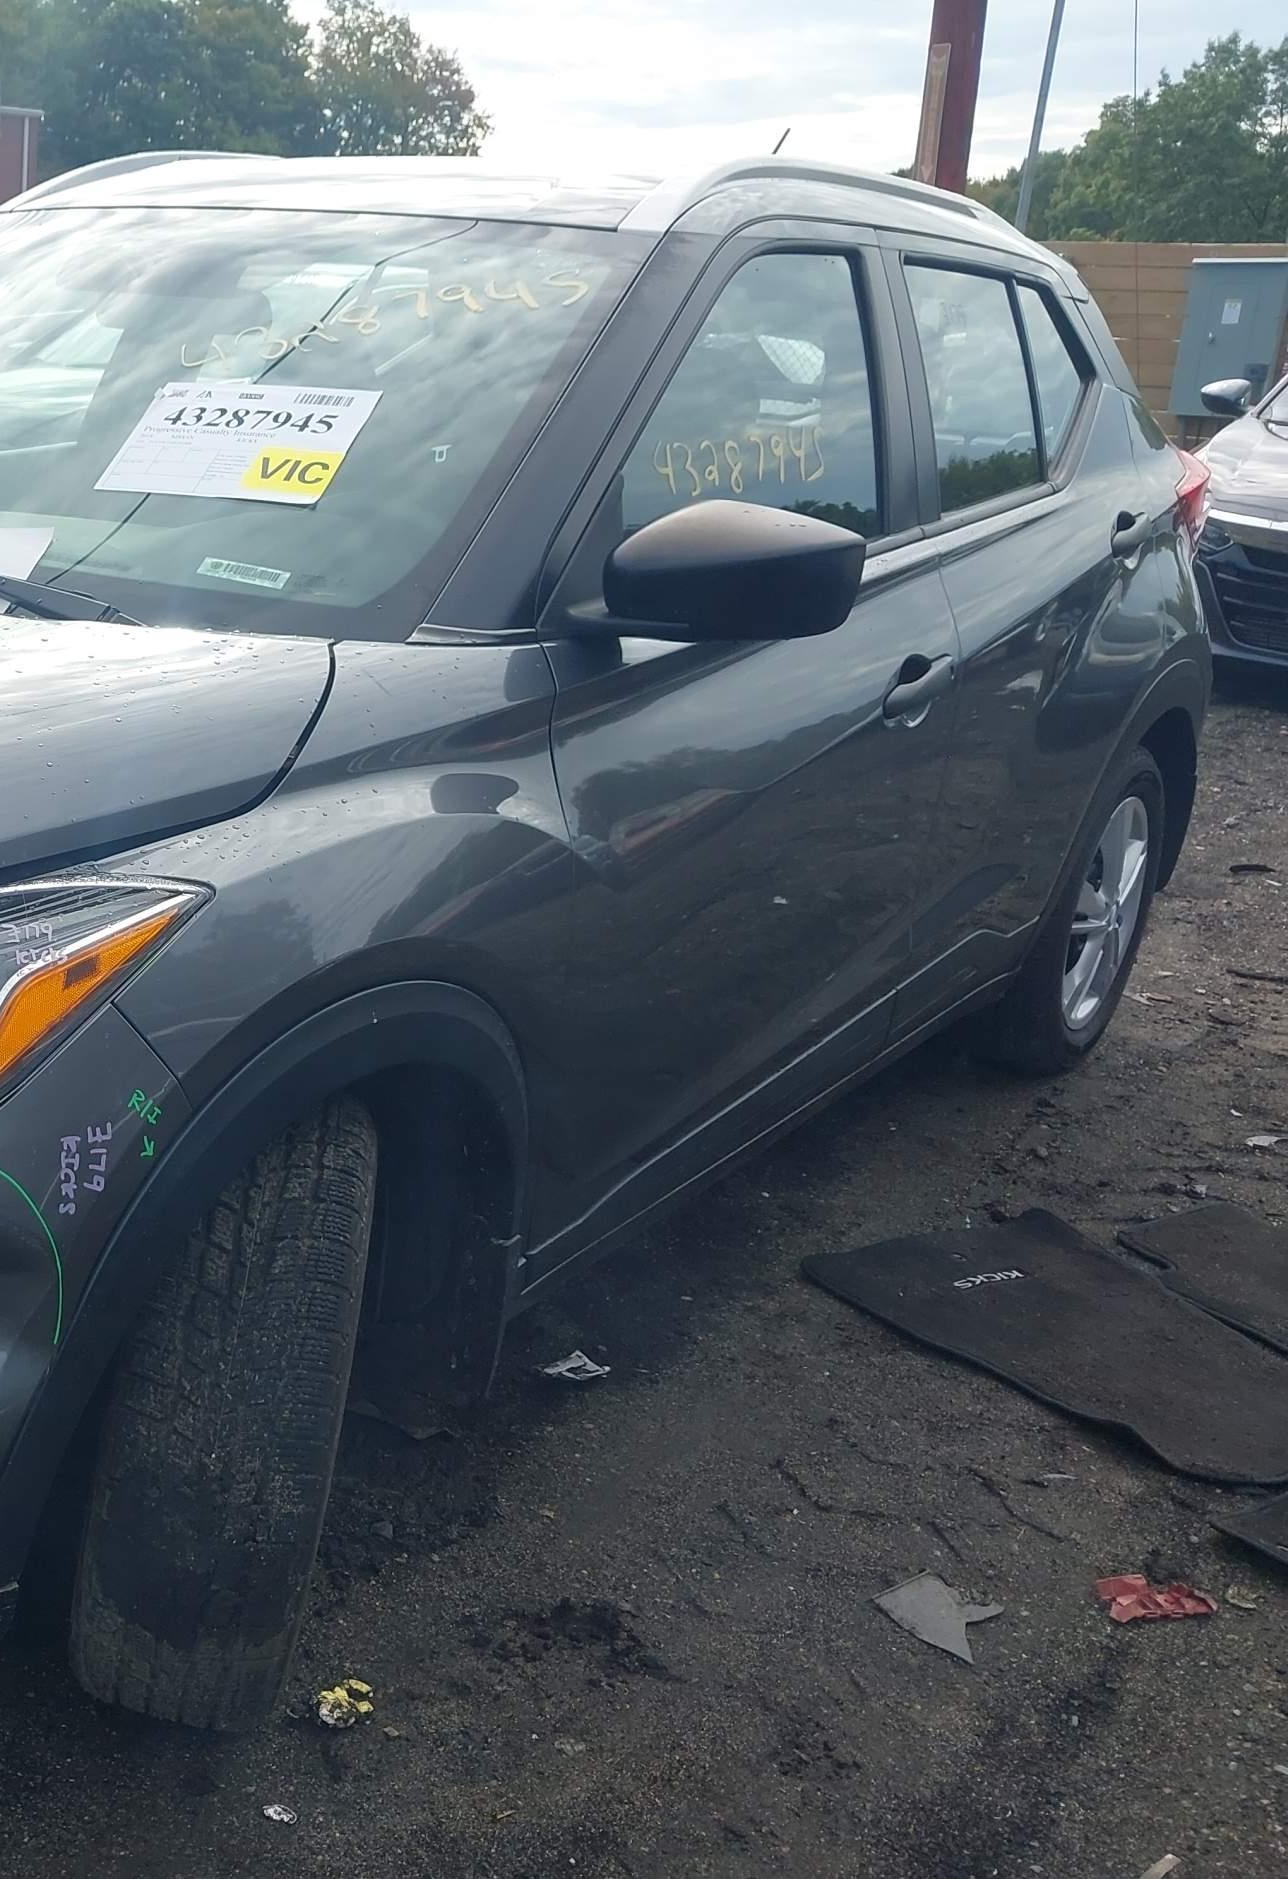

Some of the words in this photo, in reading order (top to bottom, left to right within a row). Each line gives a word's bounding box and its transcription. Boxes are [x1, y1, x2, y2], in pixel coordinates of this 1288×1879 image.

[162, 406, 339, 434] 43287945
[260, 456, 330, 484] VIC
[653, 424, 825, 497] 43287945
[58, 1135, 81, 1215] KICKS
[83, 1121, 112, 1192] 3179
[953, 1269, 1025, 1289] KICKS
